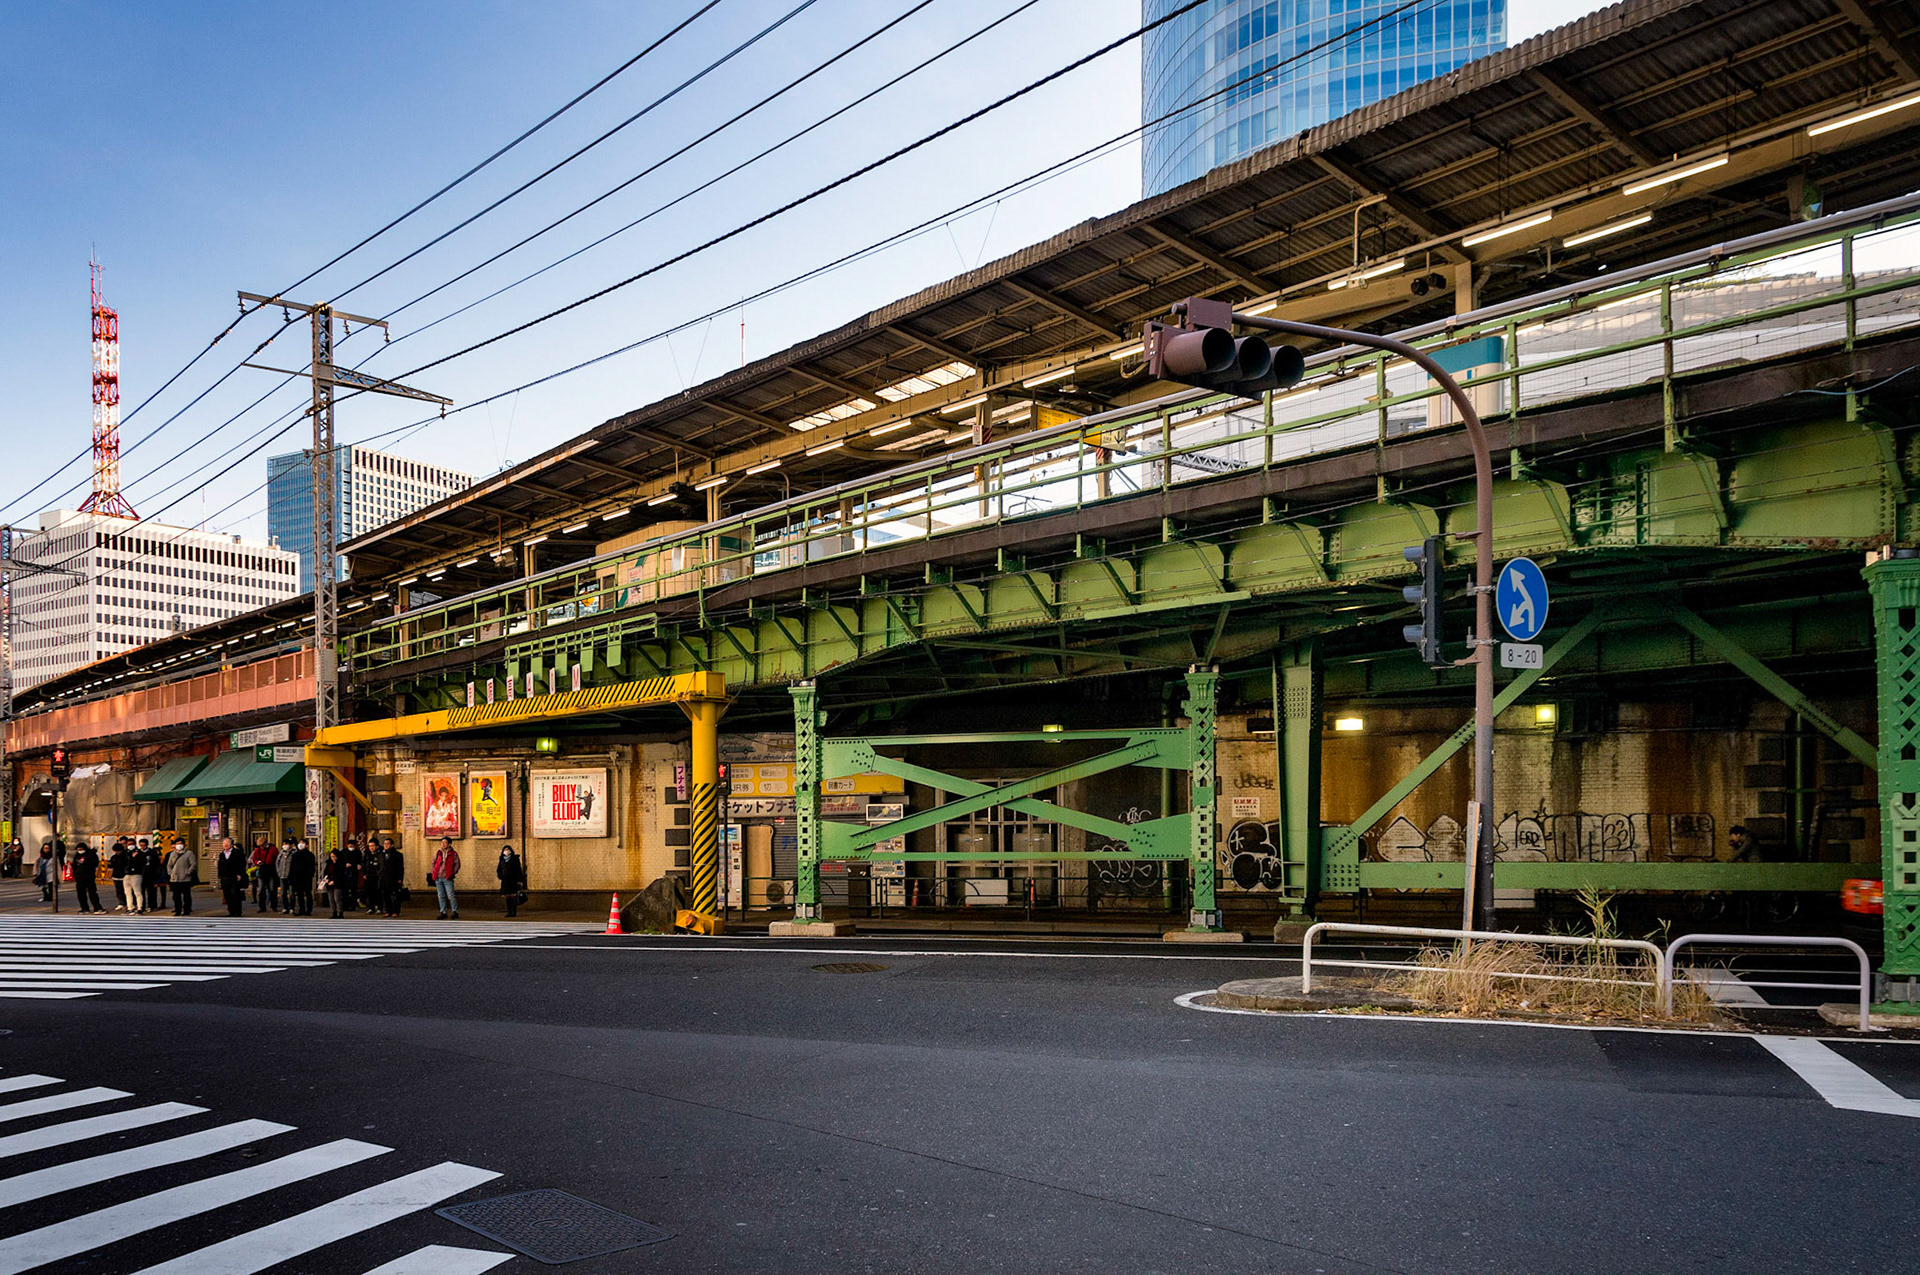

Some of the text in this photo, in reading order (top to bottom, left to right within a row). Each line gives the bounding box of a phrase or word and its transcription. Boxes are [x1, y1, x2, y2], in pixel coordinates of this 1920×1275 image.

[258, 749, 272, 757] JR
[677, 765, 685, 795] フナキ
[552, 784, 577, 802] BILLY
[552, 802, 582, 821] ELLIOT
